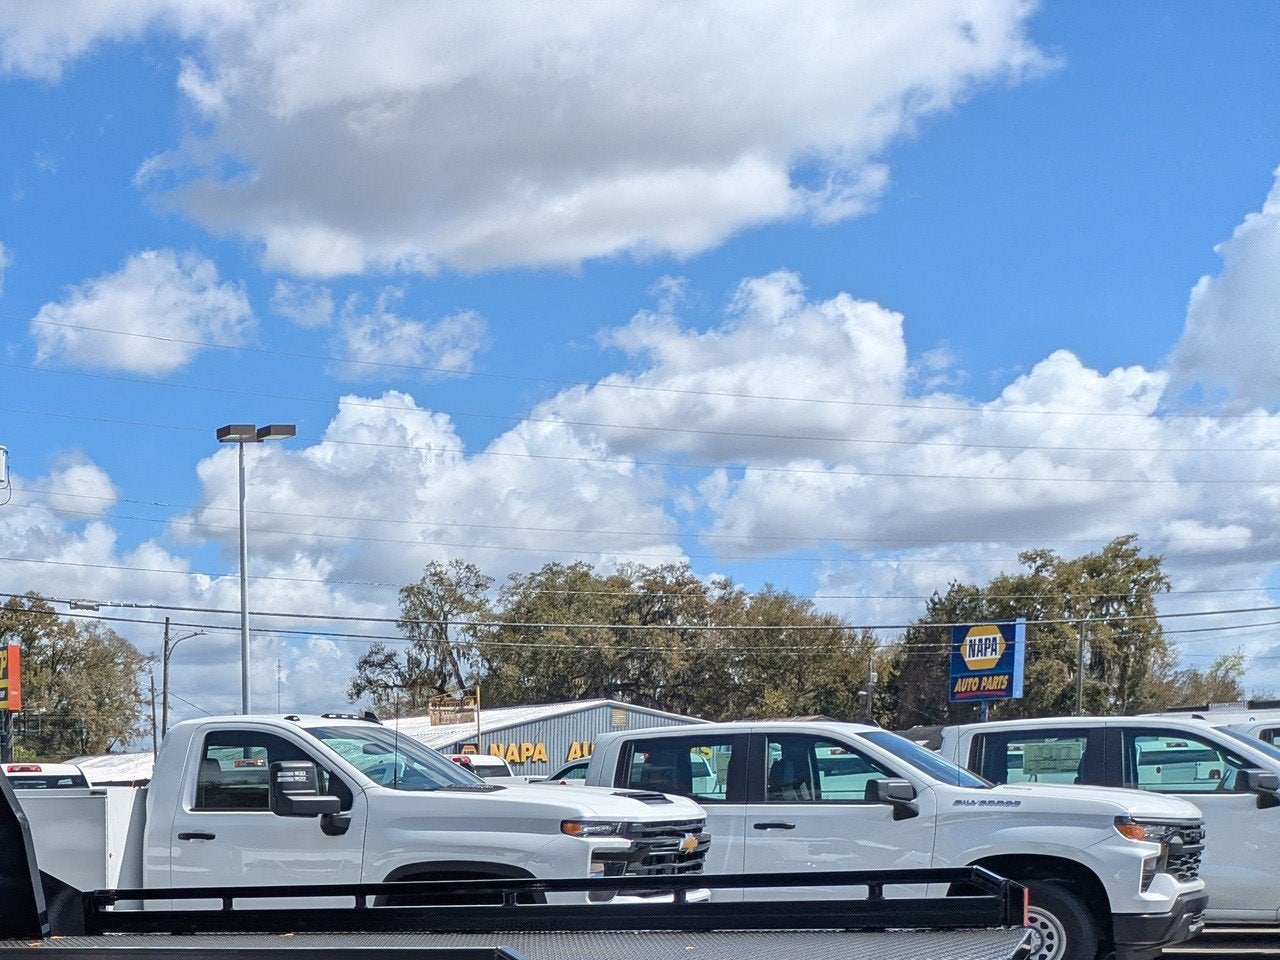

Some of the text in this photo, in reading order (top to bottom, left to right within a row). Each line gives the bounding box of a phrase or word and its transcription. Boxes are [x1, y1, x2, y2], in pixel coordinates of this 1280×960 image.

[968, 637, 998, 658] NAPA
[954, 675, 1009, 692] AUTO PARTS
[489, 742, 548, 763] NAPA
